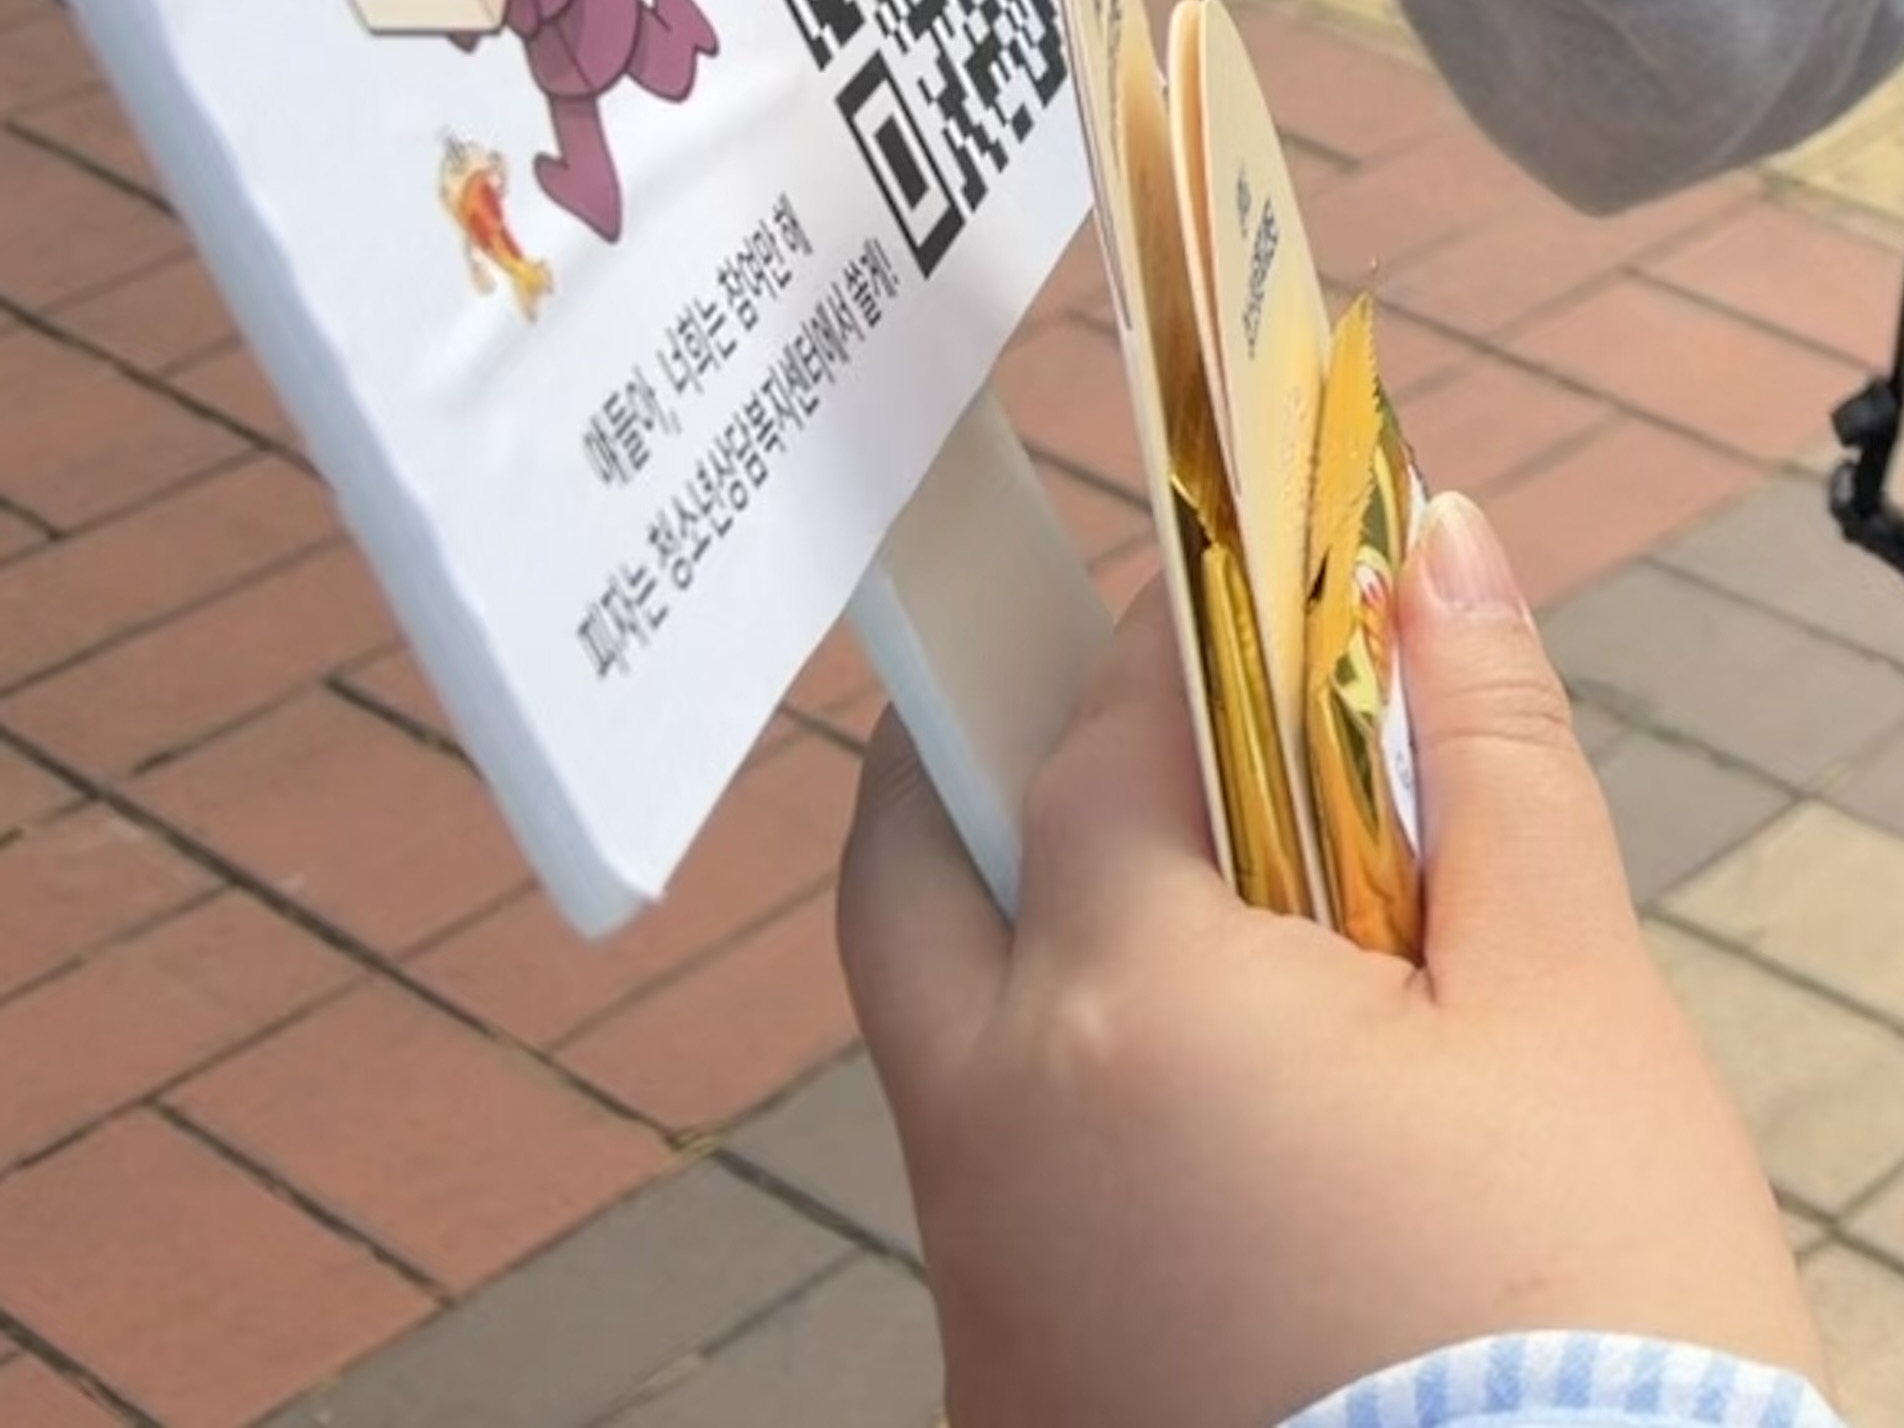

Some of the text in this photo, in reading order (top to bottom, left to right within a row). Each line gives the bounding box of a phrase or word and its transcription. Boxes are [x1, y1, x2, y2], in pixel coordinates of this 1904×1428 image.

[655, 294, 737, 396] 너희는
[717, 217, 794, 331] 참여만
[576, 562, 669, 680] 피자는
